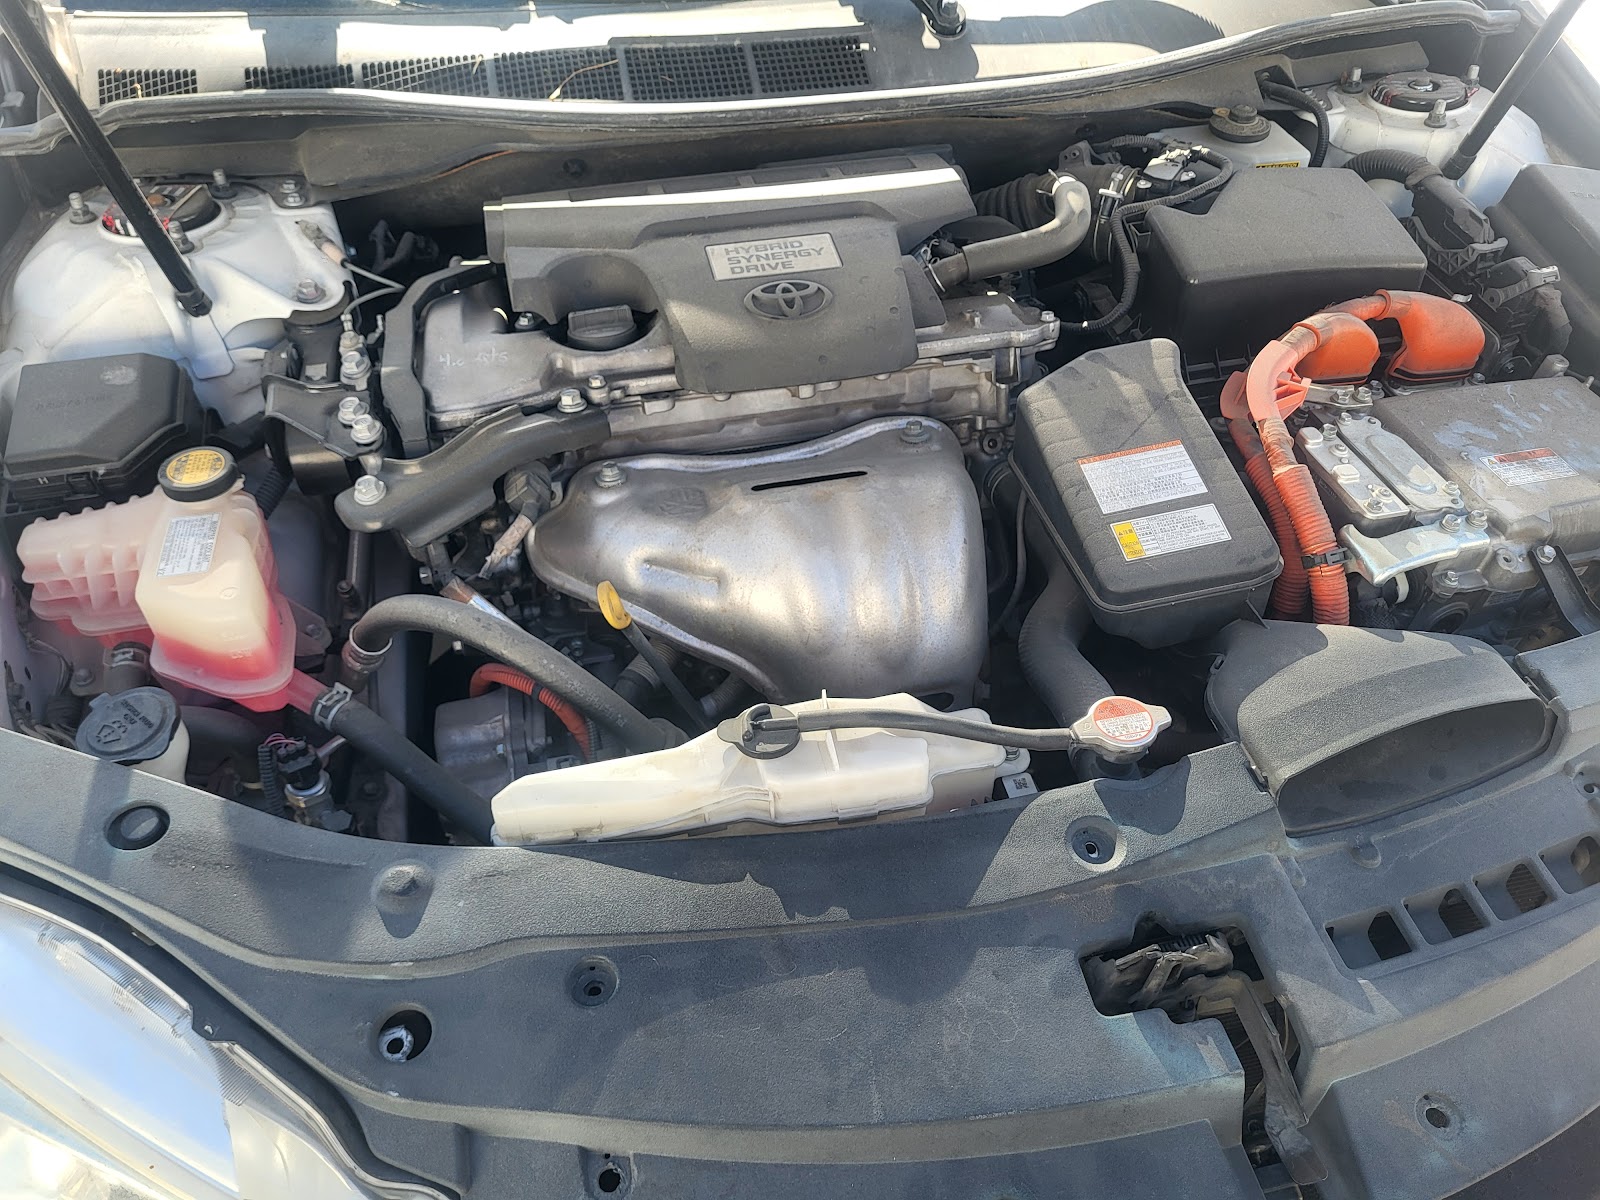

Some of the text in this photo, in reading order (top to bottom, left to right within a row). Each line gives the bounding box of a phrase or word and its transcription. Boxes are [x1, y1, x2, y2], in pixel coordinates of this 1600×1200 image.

[725, 240, 804, 256] HYBRID
[728, 247, 824, 265] SYNERGY
[730, 260, 795, 275] DRIVE
